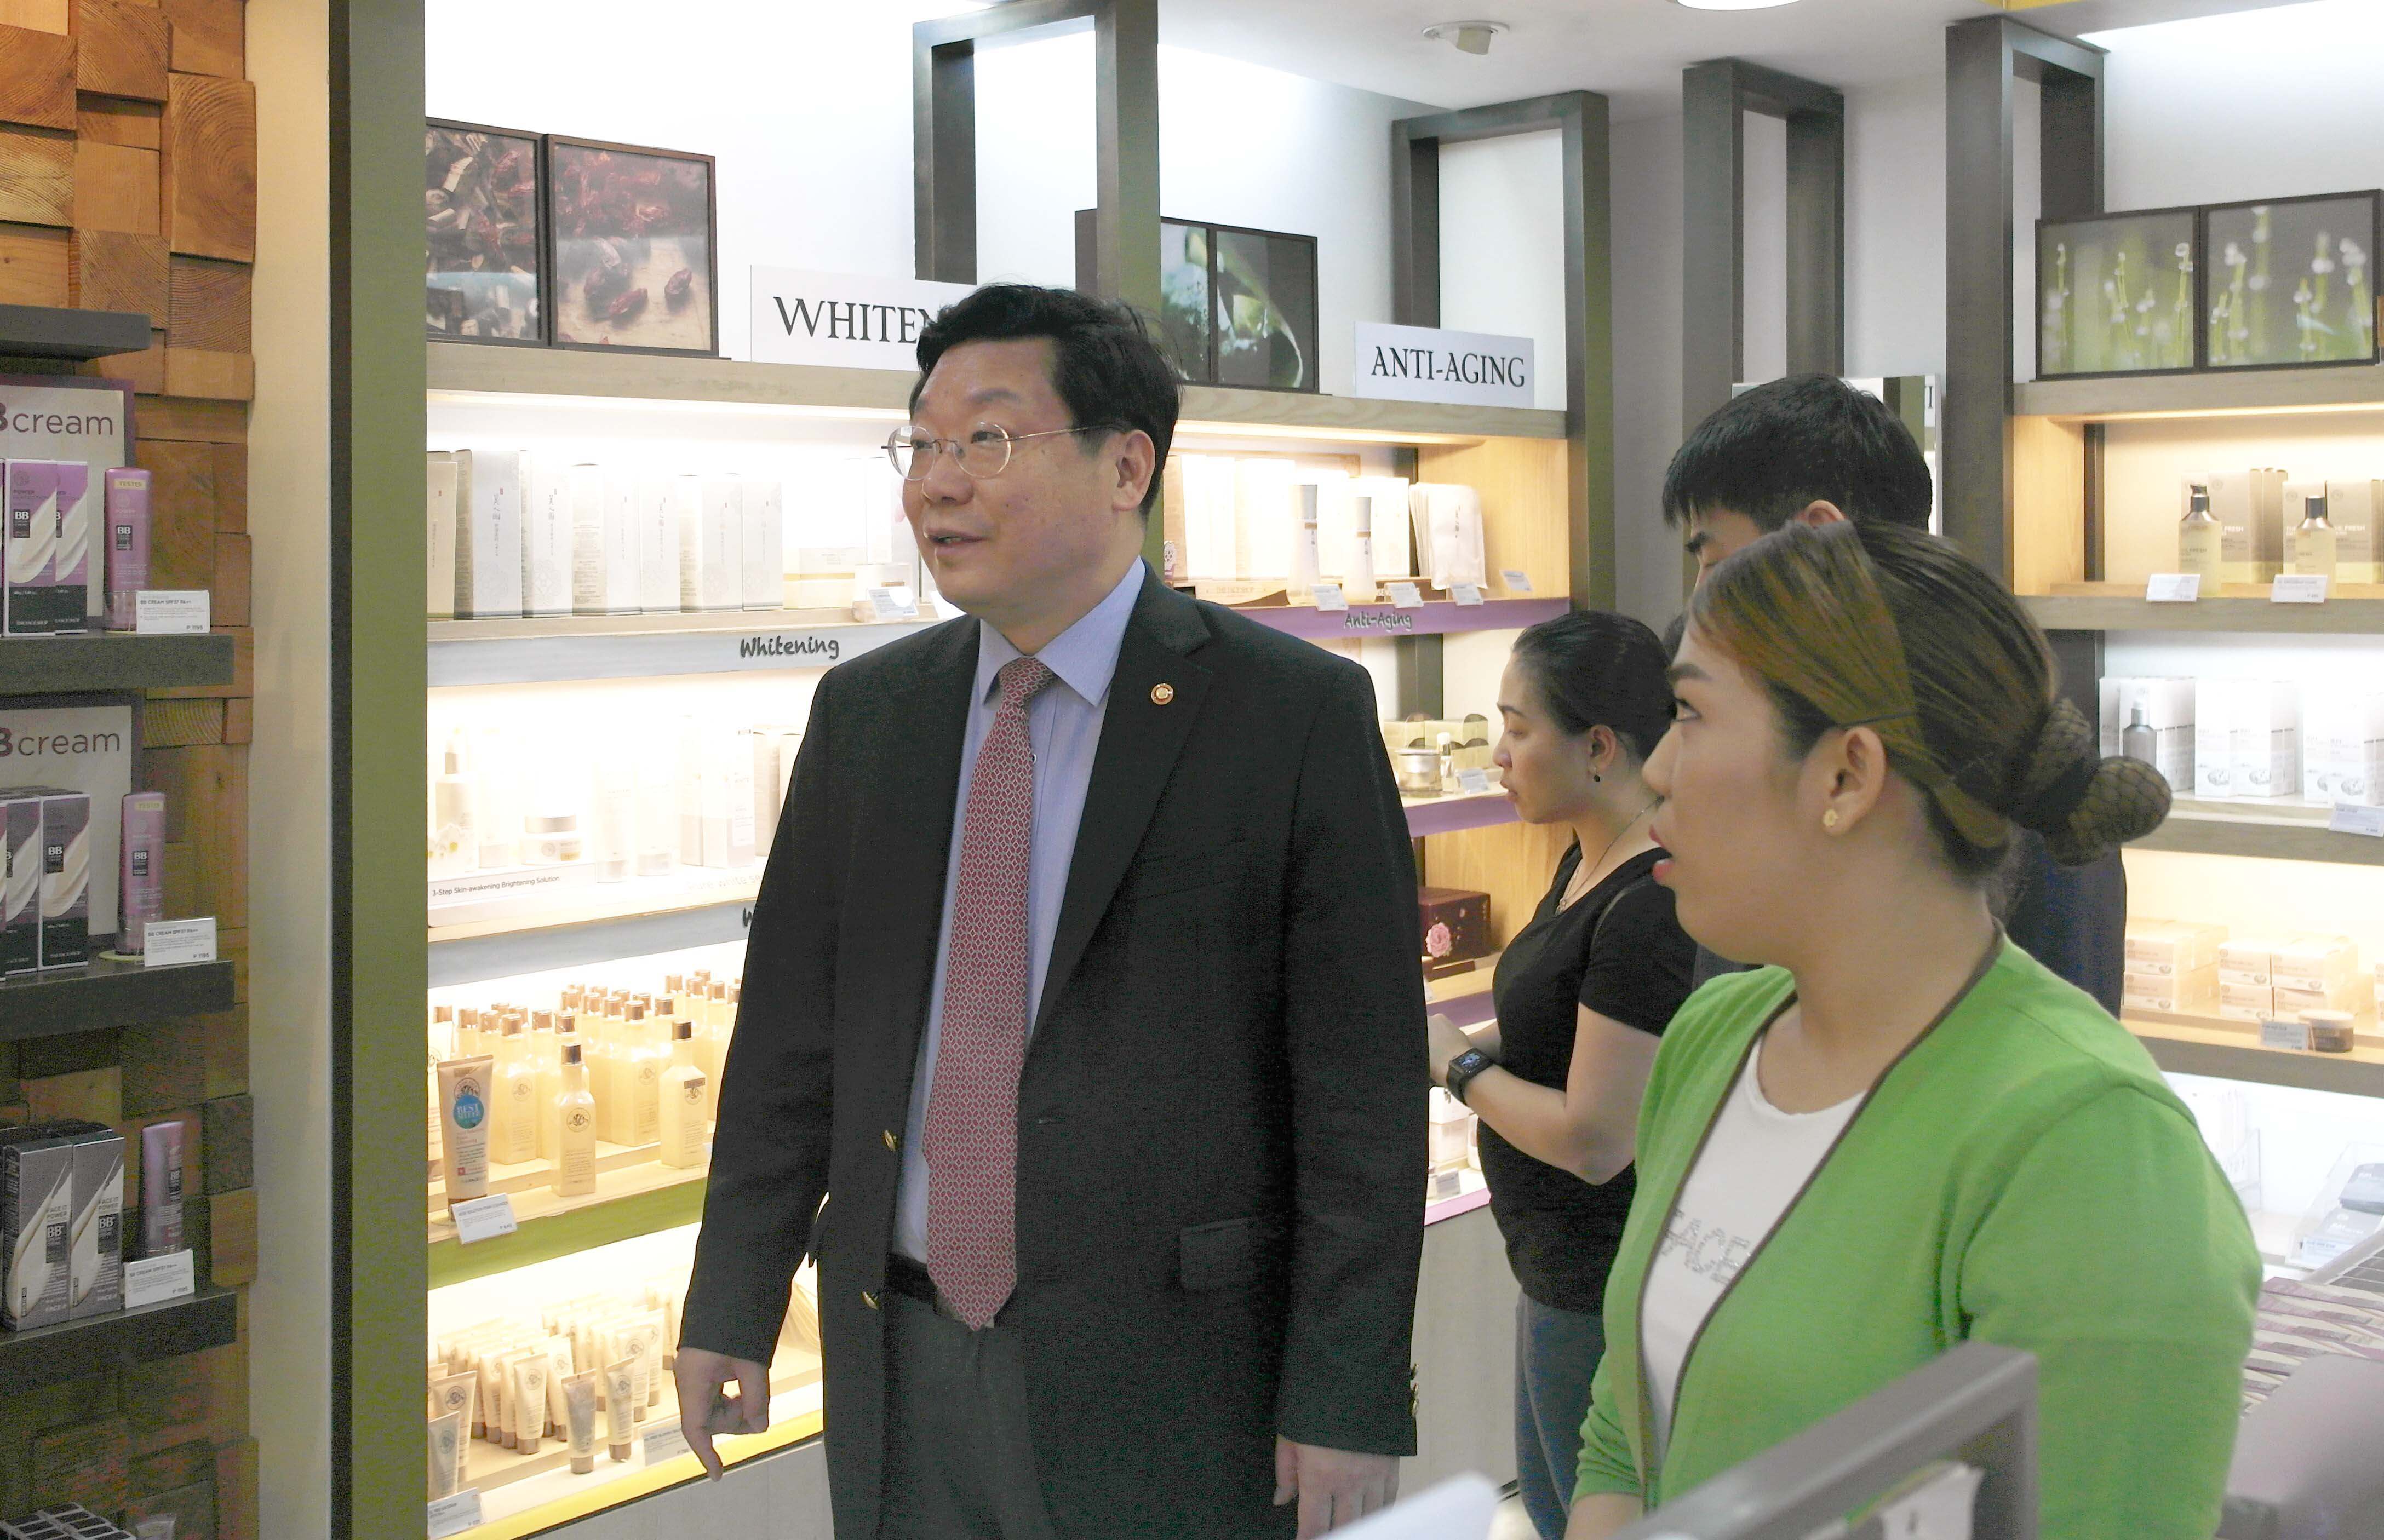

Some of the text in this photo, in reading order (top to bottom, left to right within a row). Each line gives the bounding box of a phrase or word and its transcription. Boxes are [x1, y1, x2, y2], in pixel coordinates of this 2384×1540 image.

[1371, 346, 1525, 387] ANTI-AGING
[15, 511, 30, 520] BB
[117, 527, 131, 535] BB
[1344, 611, 1412, 632] Anti-Aging
[741, 636, 839, 659] Whitening
[48, 846, 62, 855] BB
[134, 852, 147, 860] BB
[454, 883, 500, 894] Skin-awakening
[501, 878, 535, 888] Brightening
[536, 876, 560, 884] Solution
[99, 1217, 114, 1228] BB
[48, 1226, 63, 1238] BB
